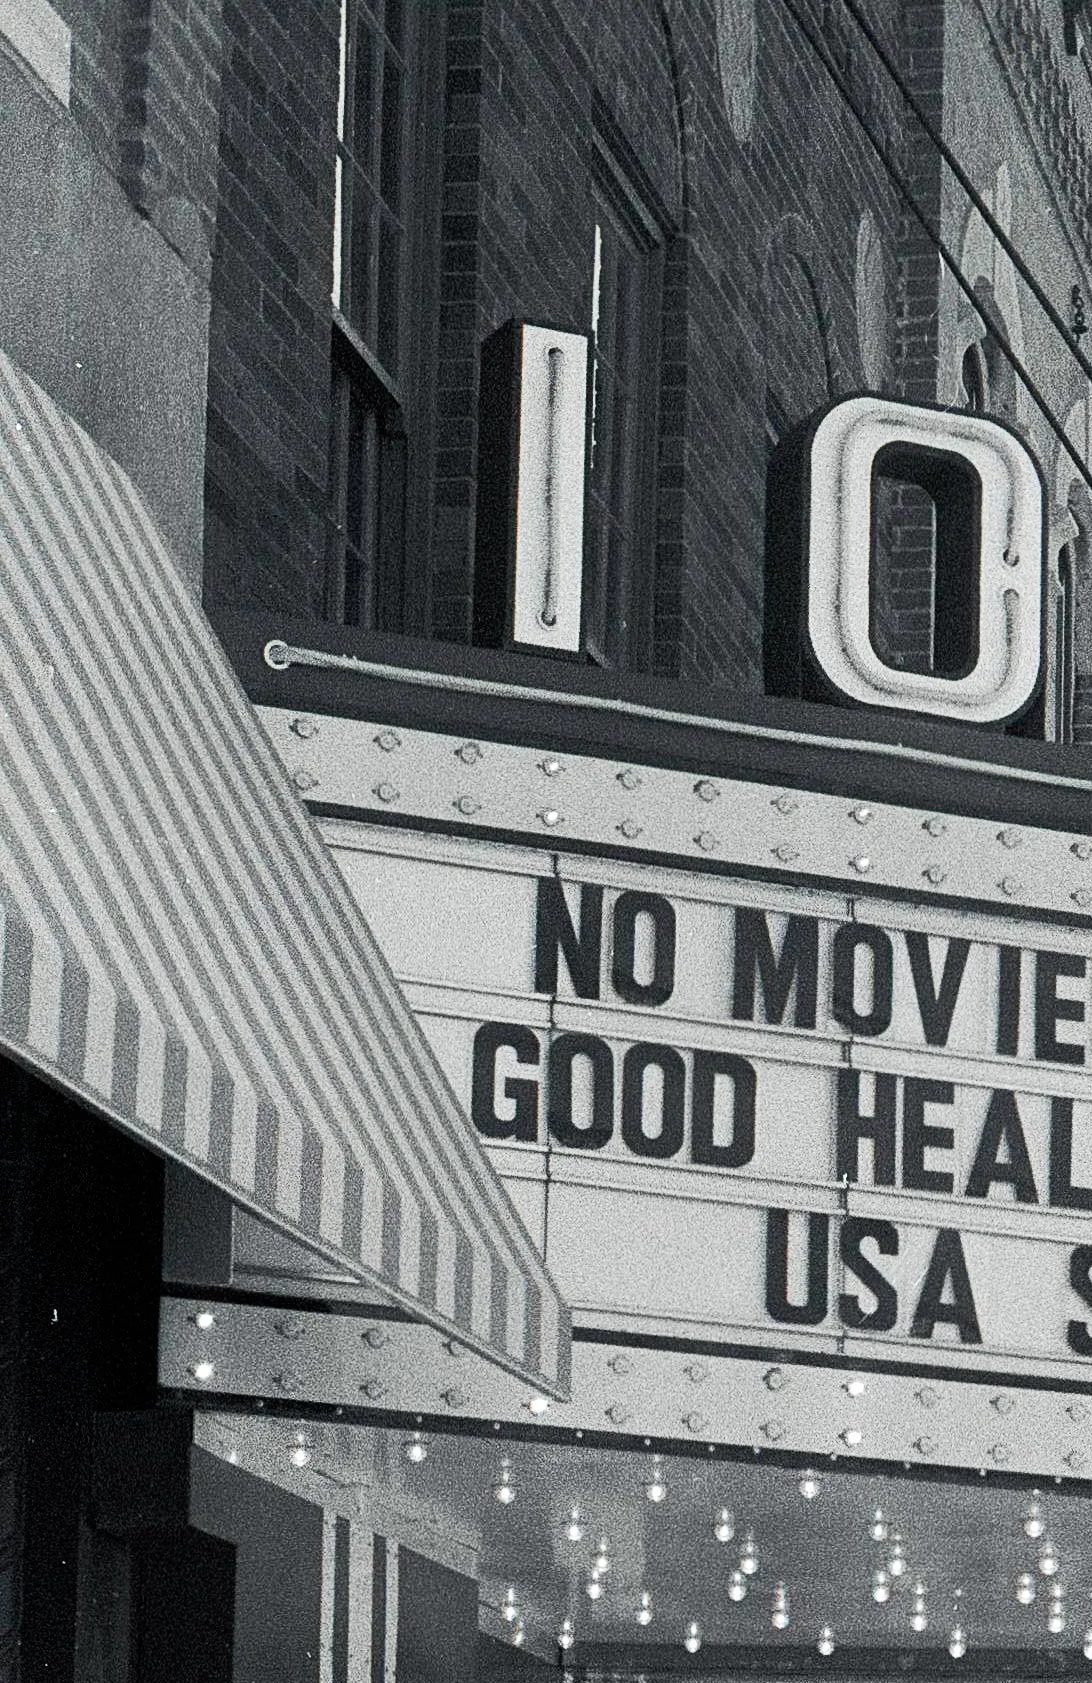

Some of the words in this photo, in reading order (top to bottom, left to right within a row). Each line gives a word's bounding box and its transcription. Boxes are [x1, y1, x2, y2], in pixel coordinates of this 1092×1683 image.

[534, 876, 676, 1006] NO
[471, 1021, 758, 1168] GOOD
[765, 1207, 984, 1345] USA
